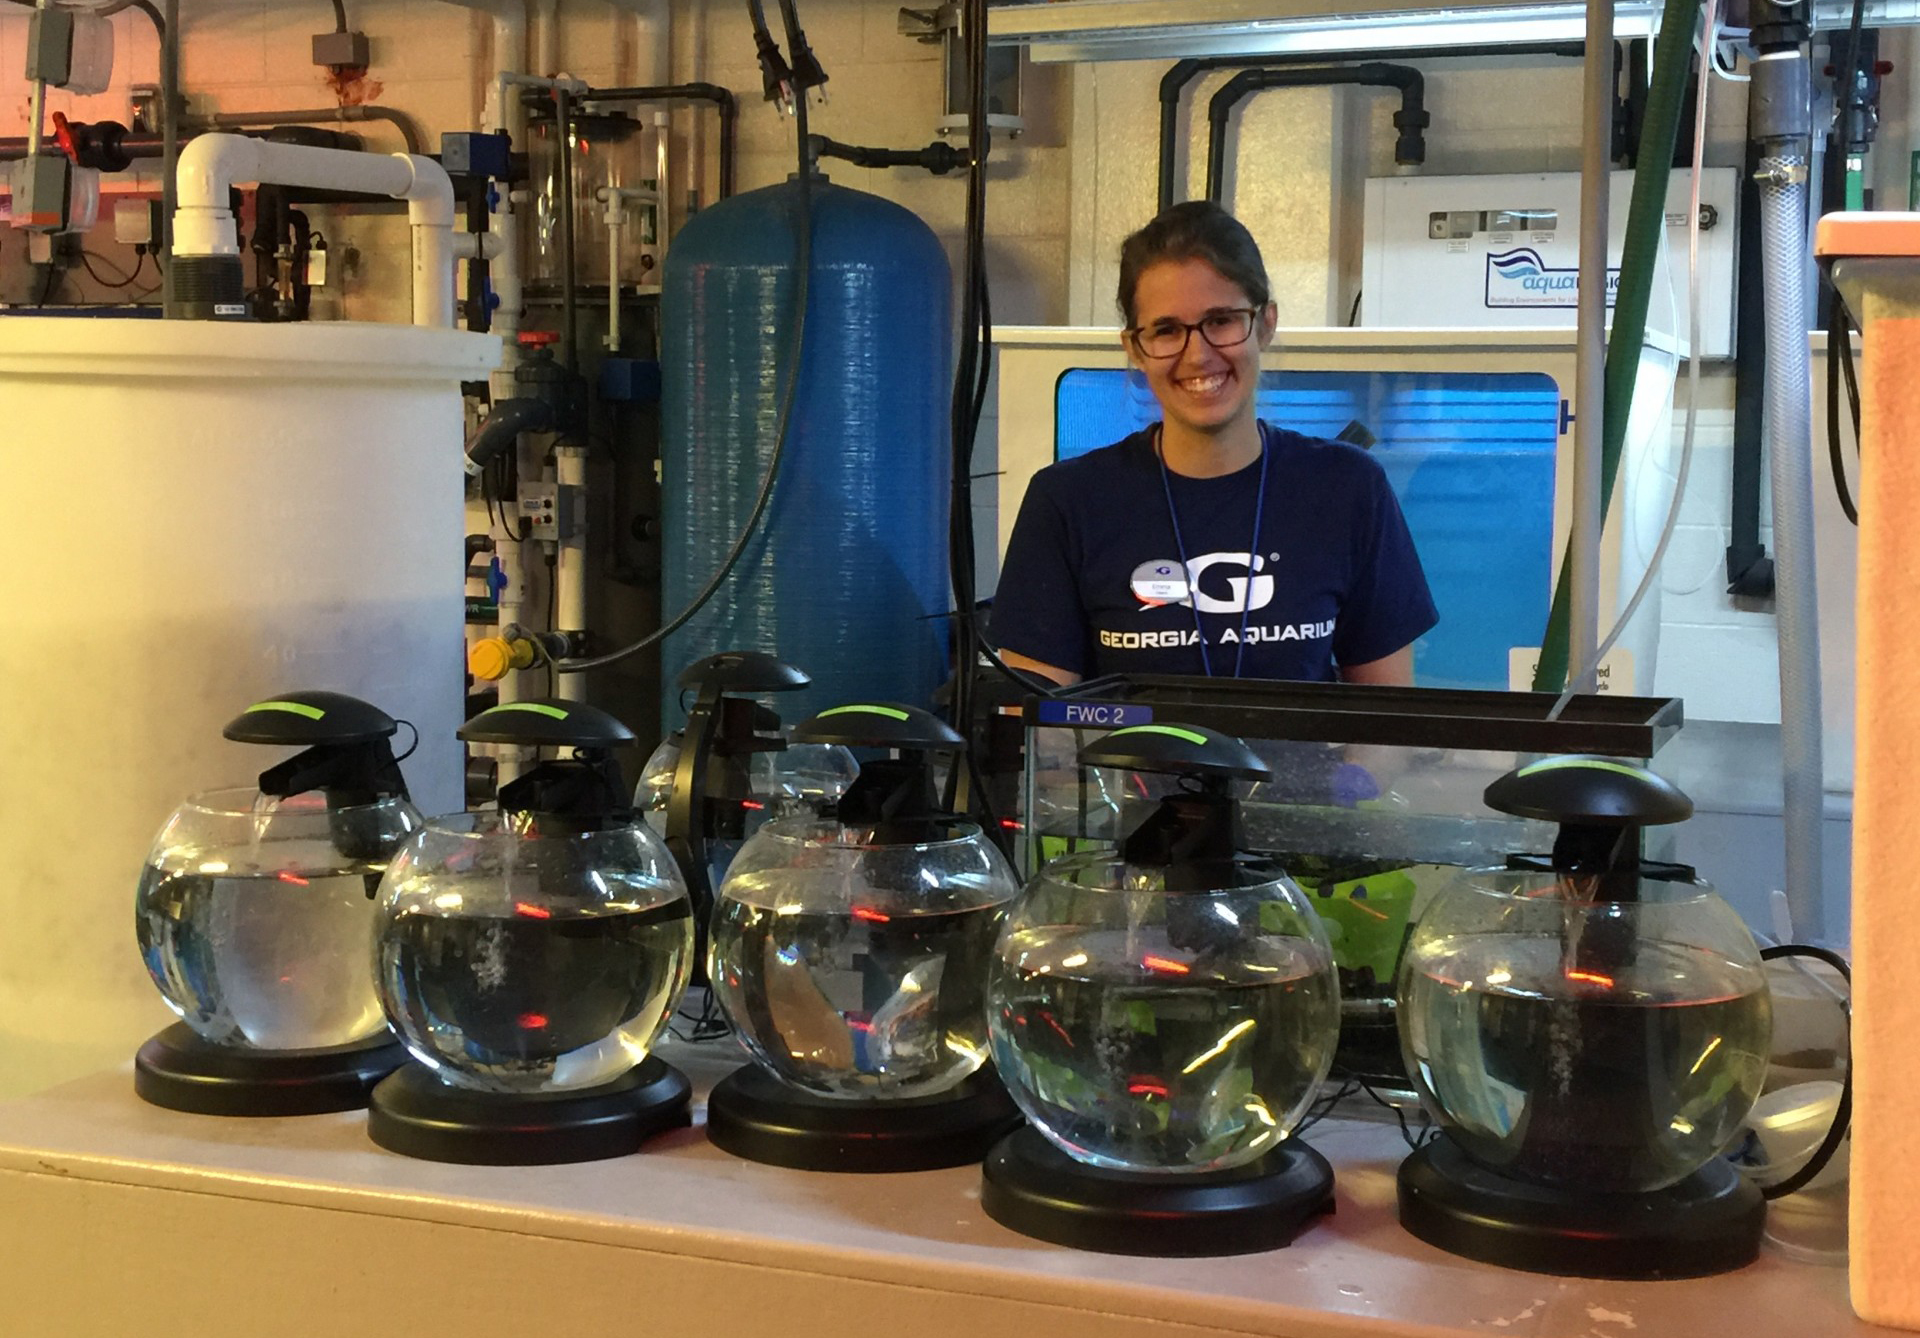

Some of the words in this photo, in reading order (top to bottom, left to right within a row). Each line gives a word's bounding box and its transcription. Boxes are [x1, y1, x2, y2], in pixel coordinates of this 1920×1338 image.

[1100, 630, 1208, 649] GEORGIA
[1219, 618, 1336, 645] AQUARIUM
[1066, 705, 1108, 724] FWC
[1113, 707, 1124, 724] 2
